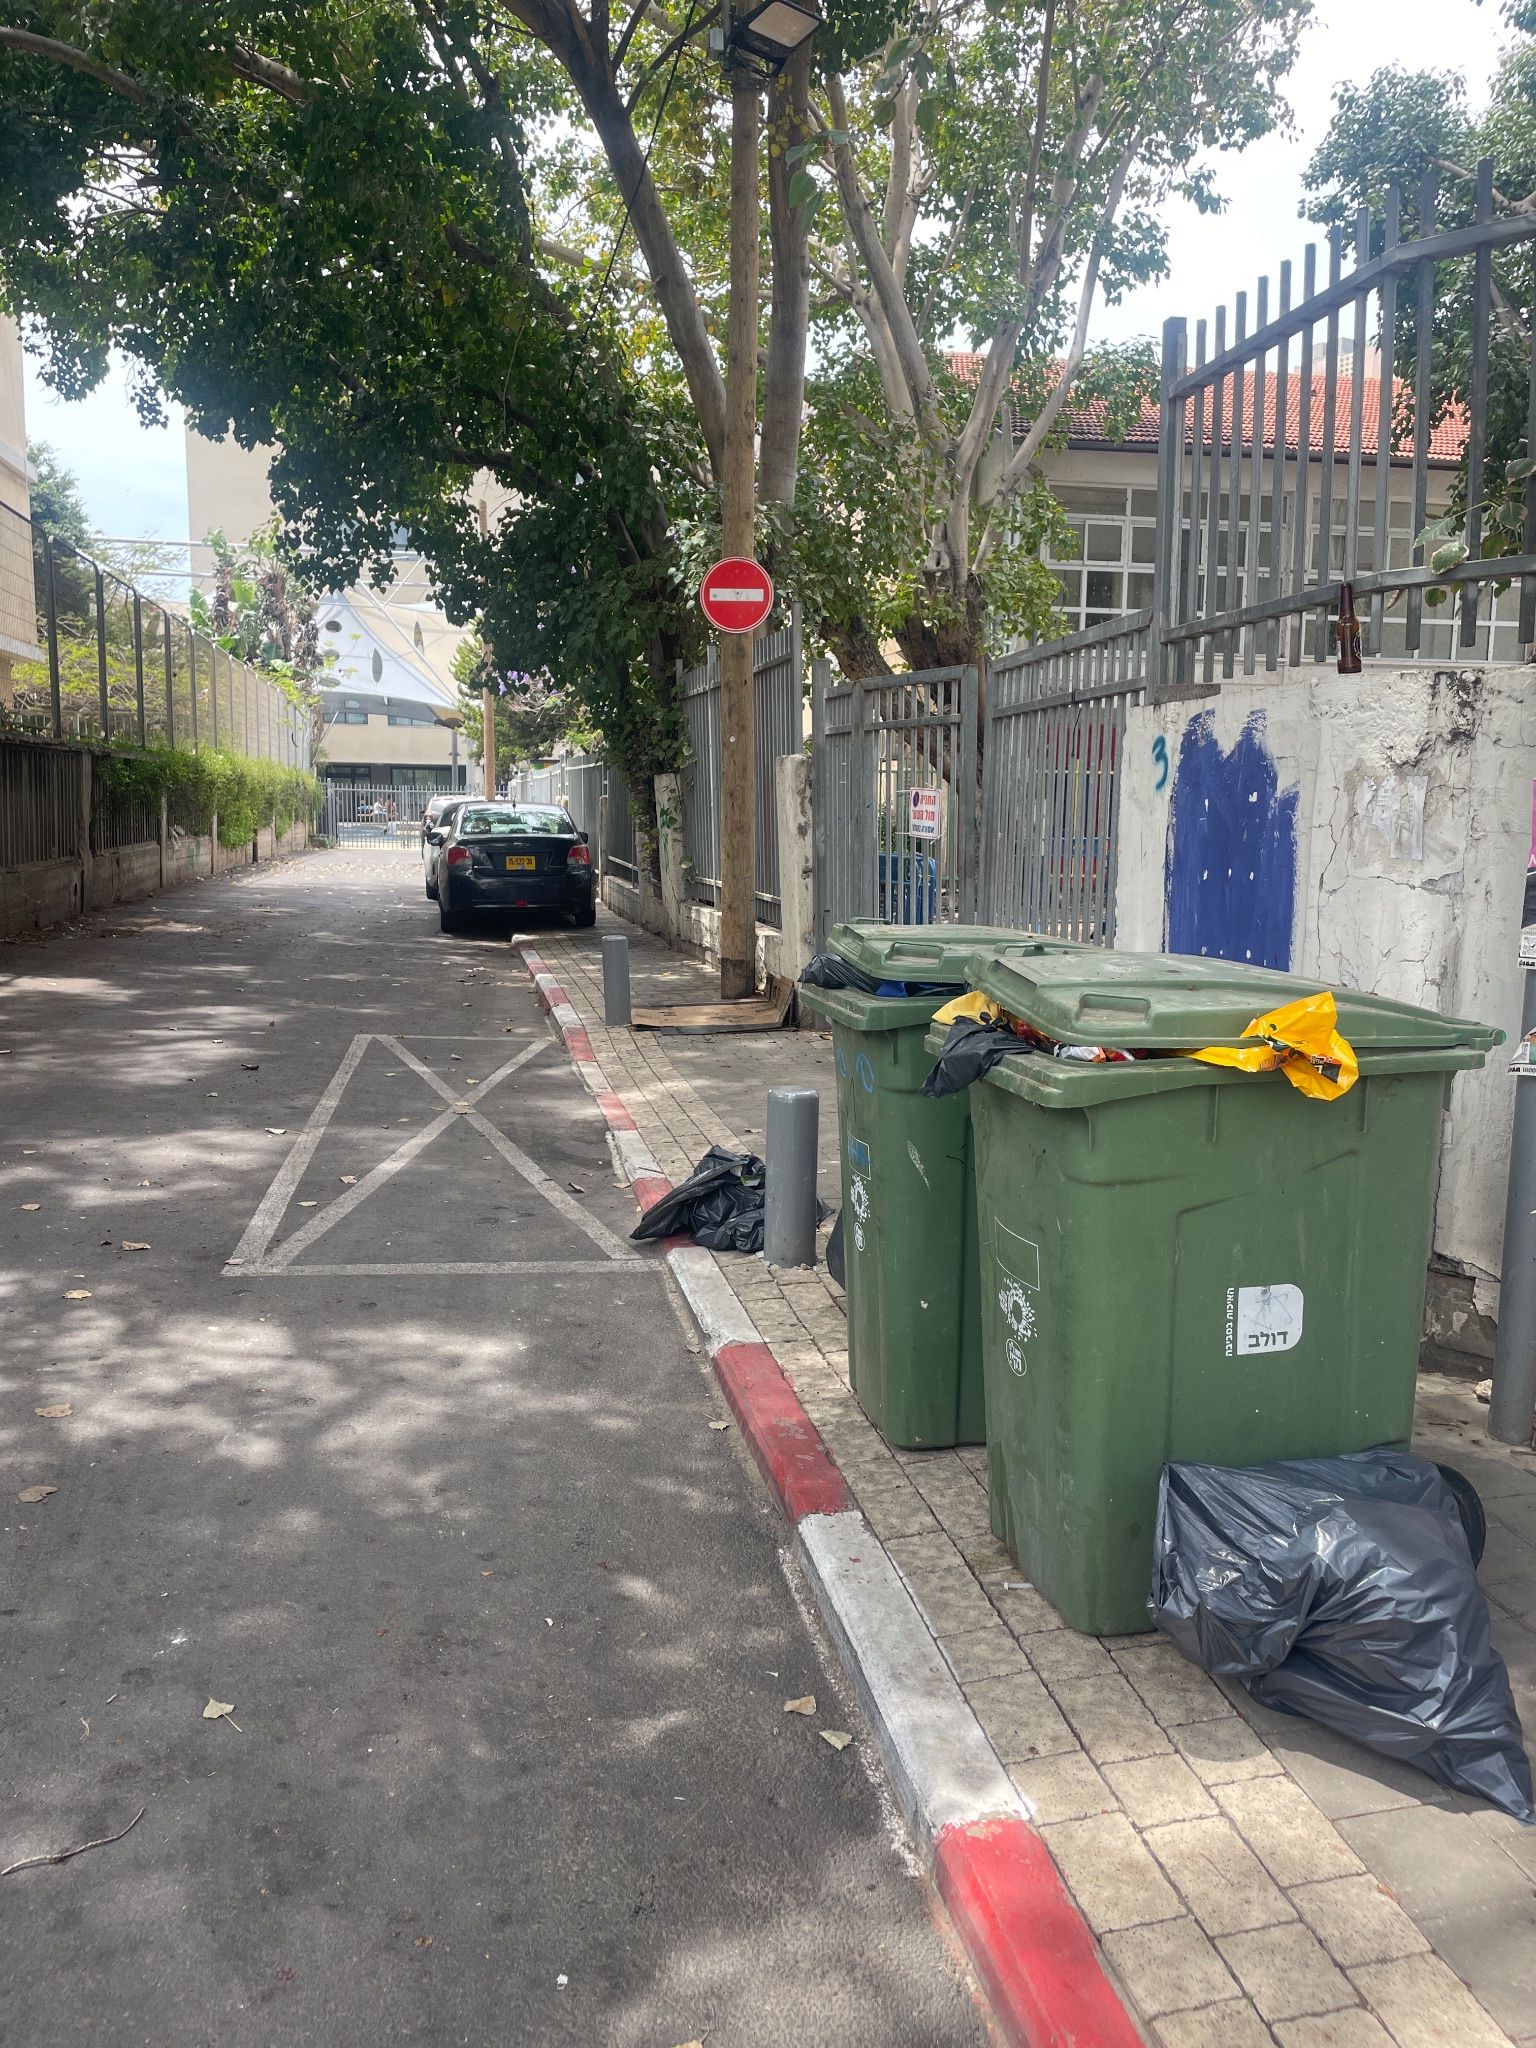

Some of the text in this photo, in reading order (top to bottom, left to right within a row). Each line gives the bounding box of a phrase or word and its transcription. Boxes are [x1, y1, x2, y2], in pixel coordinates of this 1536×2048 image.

[1225, 1287, 1235, 1357] האיכות בסביבה
[1248, 1331, 1289, 1349] דולב
